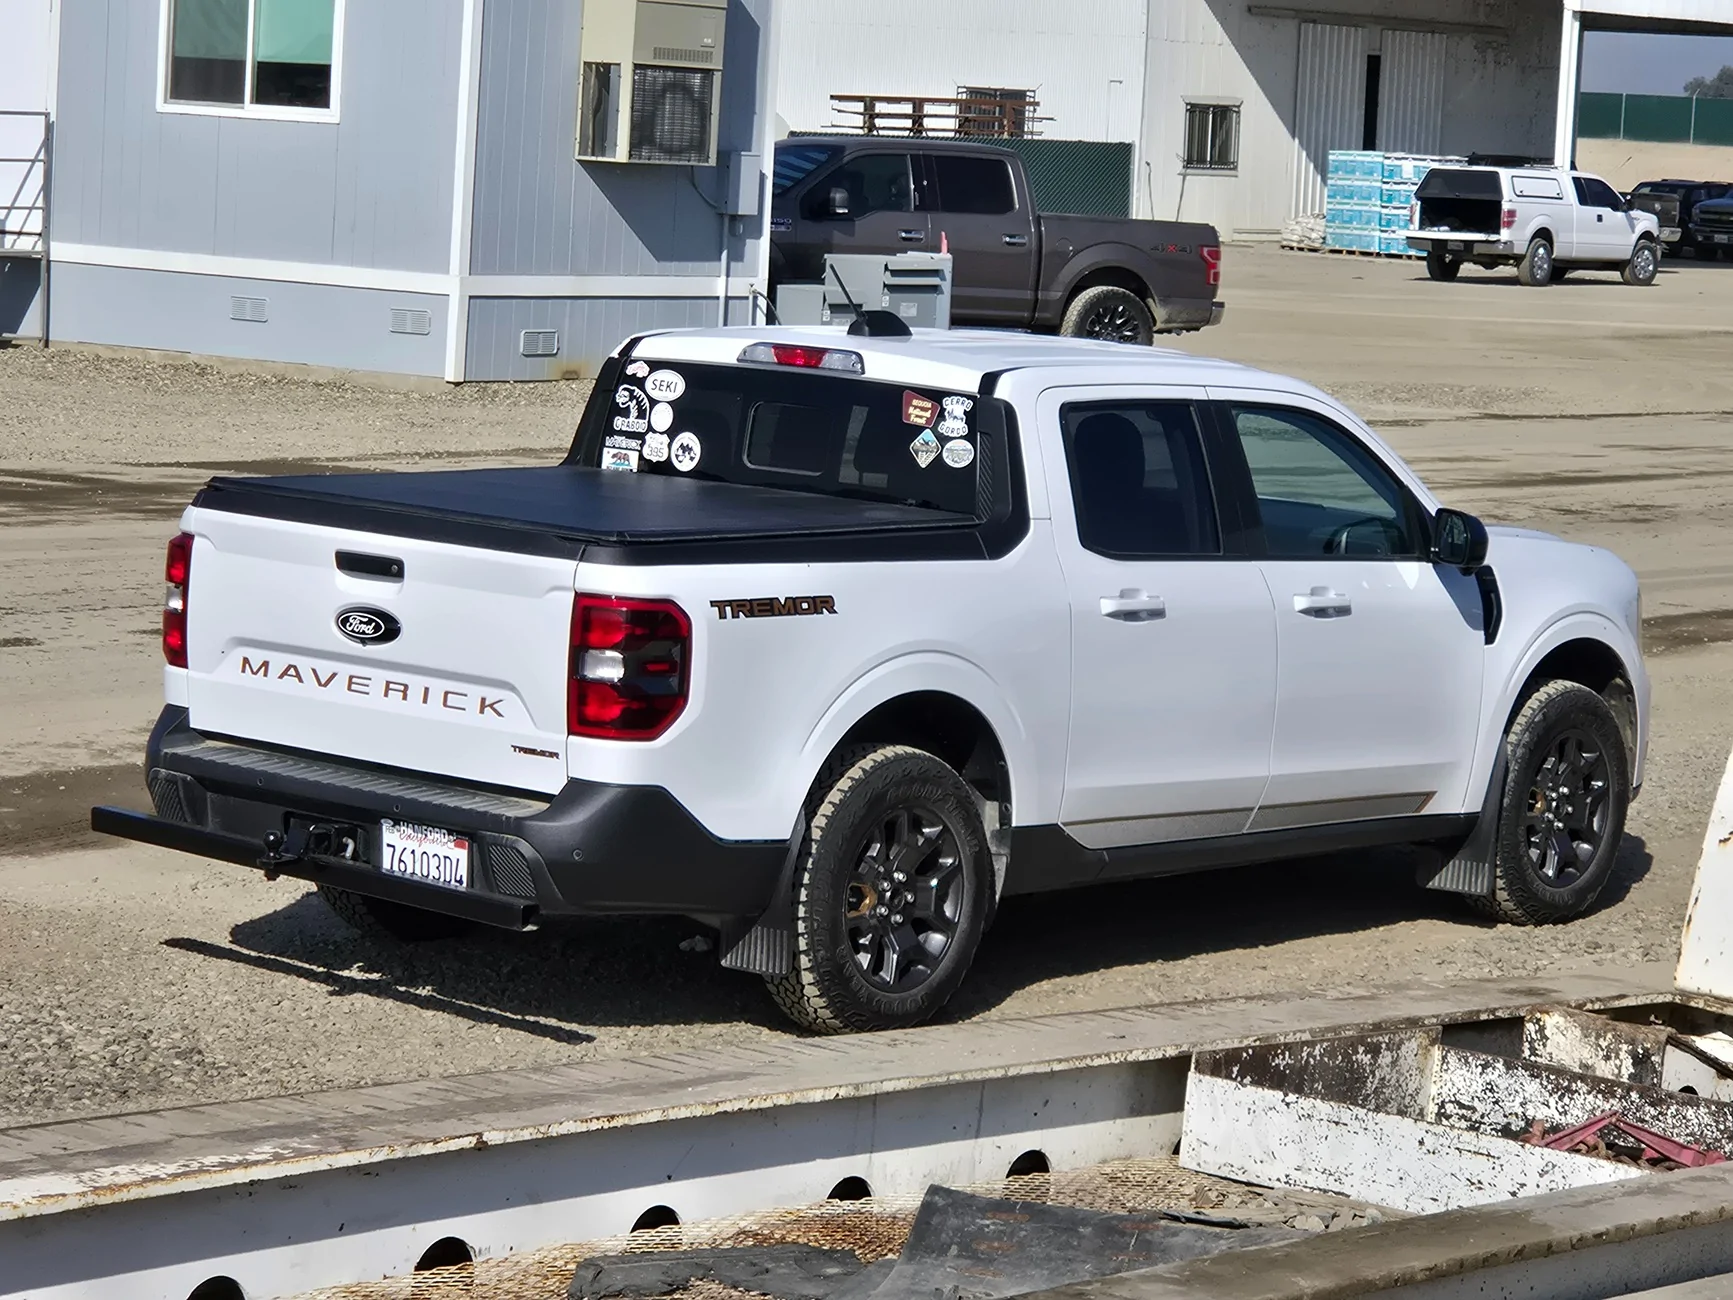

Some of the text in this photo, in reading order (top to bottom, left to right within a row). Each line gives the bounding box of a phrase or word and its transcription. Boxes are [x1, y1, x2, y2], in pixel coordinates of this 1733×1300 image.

[651, 379, 678, 393] SEKI
[944, 397, 972, 409] CERRO
[939, 423, 967, 435] GORDO
[647, 444, 664, 458] 395
[709, 595, 838, 620] TREMOR
[345, 612, 376, 635] Ford
[241, 656, 505, 718] MAVERICK
[511, 744, 560, 760] TREMOR
[400, 821, 448, 842] HANFORD
[386, 843, 464, 886] 76103D4
